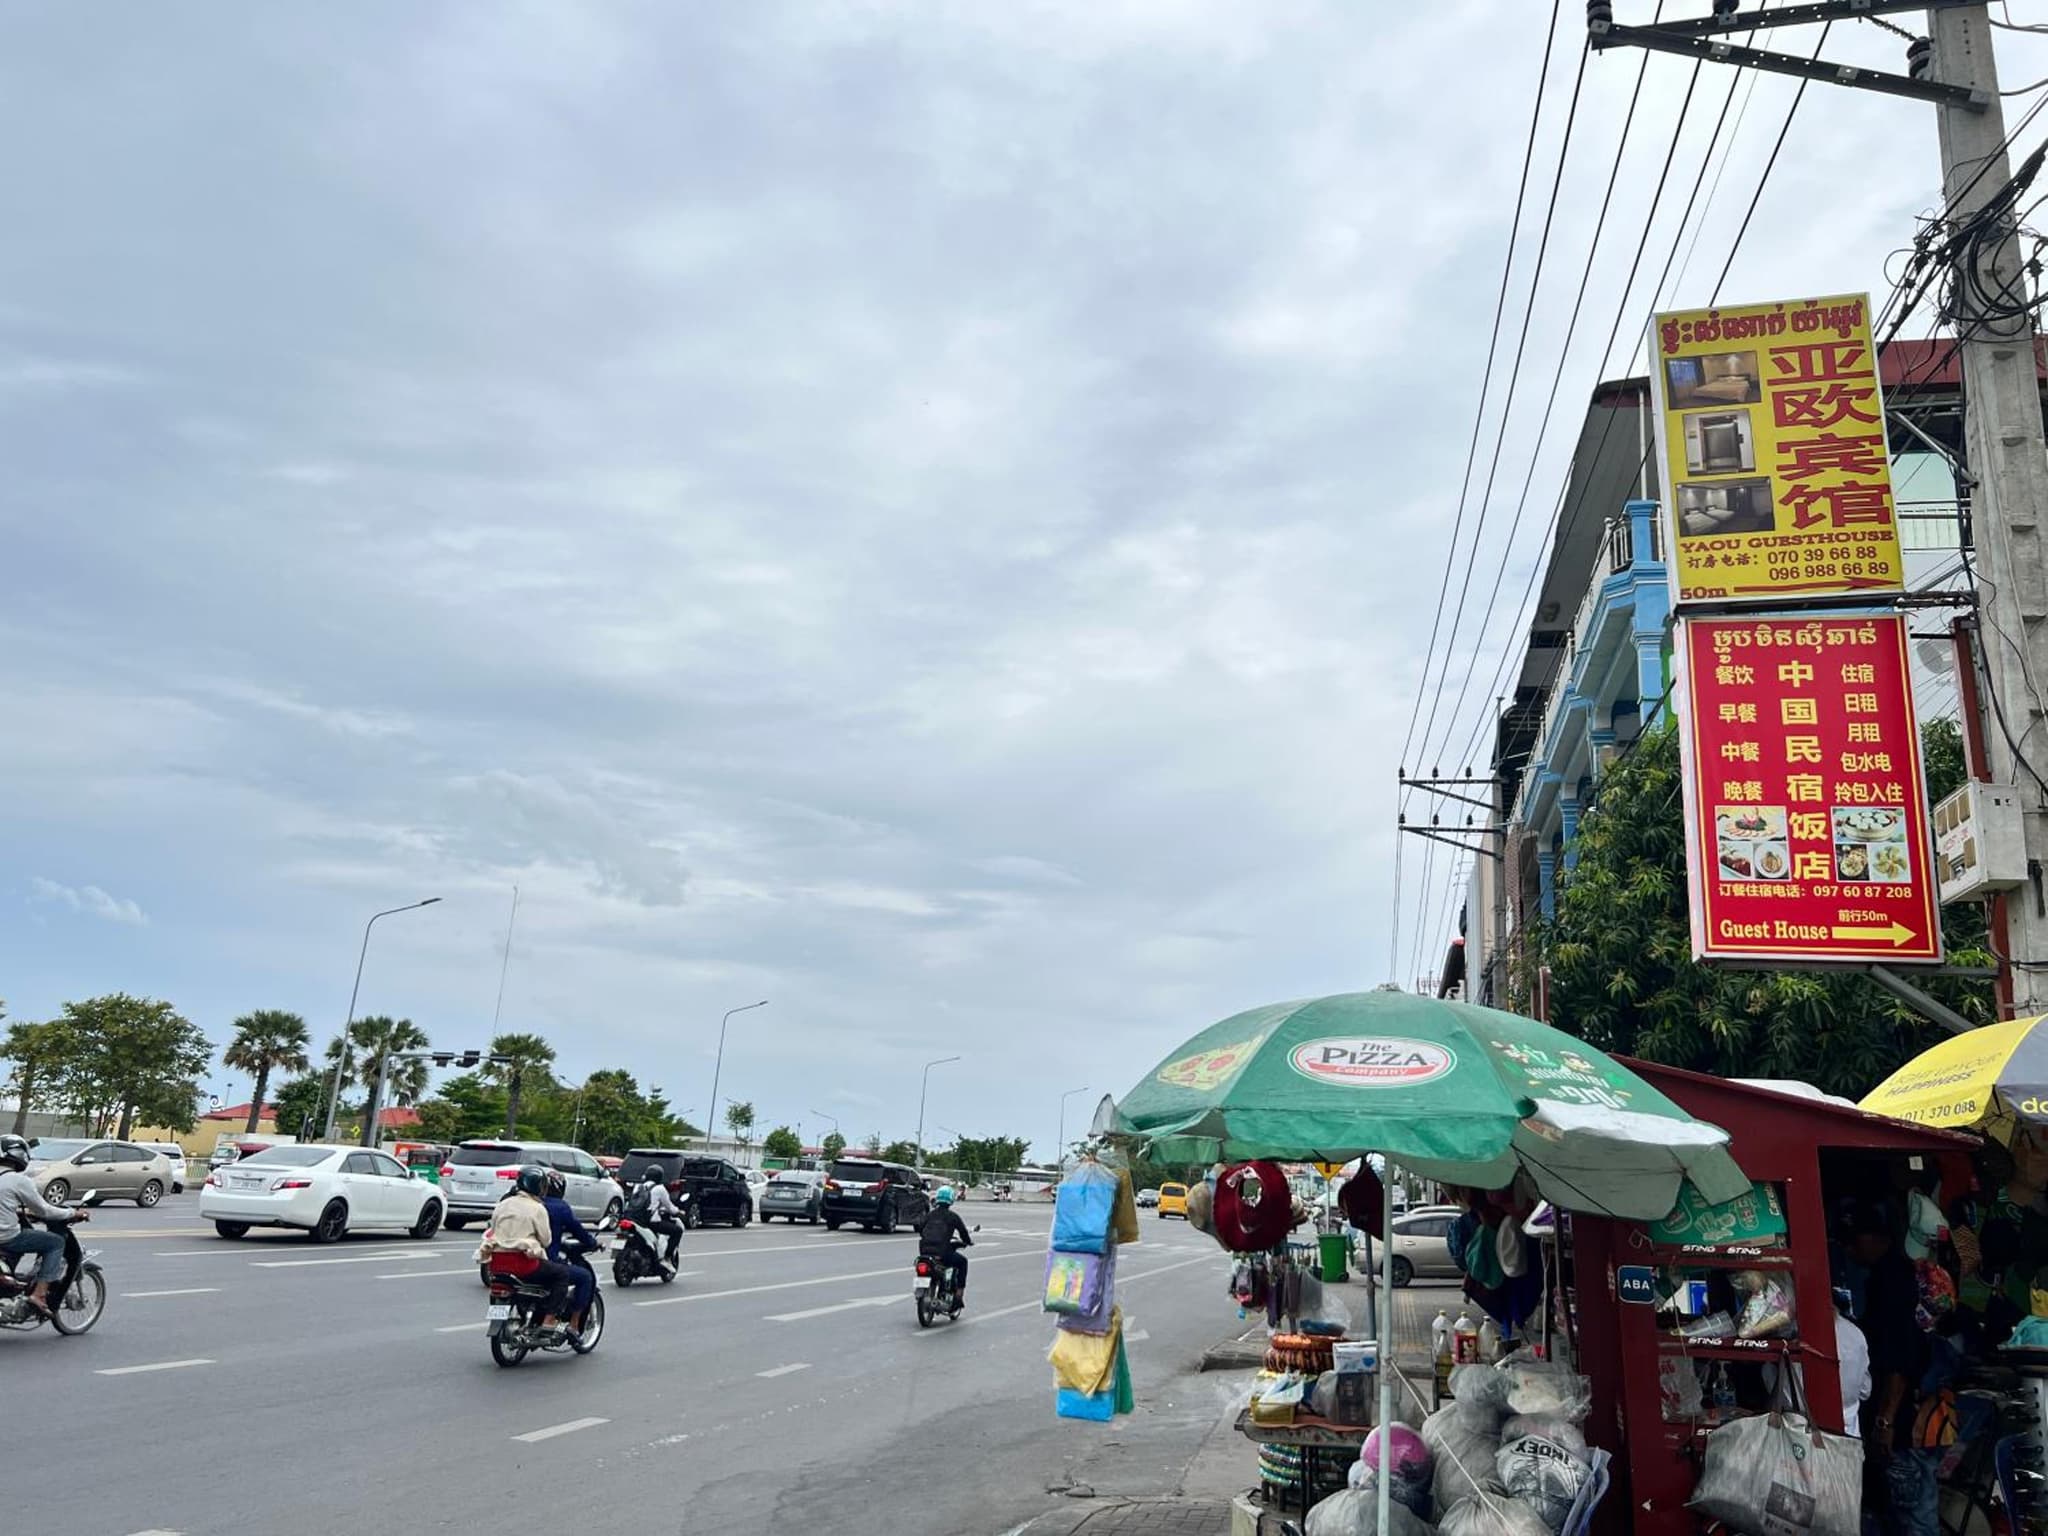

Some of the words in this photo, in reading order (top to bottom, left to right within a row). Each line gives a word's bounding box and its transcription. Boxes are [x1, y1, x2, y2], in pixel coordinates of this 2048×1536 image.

[1767, 340, 1892, 530] 亚欧宾馆
[1680, 538, 1740, 553] YAOU
[1747, 530, 1894, 548] GUESTHOUSE
[1768, 550, 1799, 565] 070
[1804, 549, 1825, 562] 39
[1829, 547, 1851, 560] 66
[1855, 546, 1877, 559] 88
[1769, 566, 1800, 581] 096
[1805, 564, 1837, 578] 988
[1841, 562, 1863, 576] 66
[1868, 561, 1889, 575] 89
[1680, 586, 1728, 600] 50m
[1715, 665, 1755, 685] 餐饮
[1841, 664, 1875, 684] 住宿
[1844, 693, 1878, 713] 日租
[1719, 703, 1757, 724] 早餐
[1848, 723, 1881, 743] 月租
[1721, 741, 1760, 762] 中餐
[1777, 660, 1831, 881] 中国民宿饭店
[1840, 752, 1892, 773] 包水电
[1723, 780, 1763, 801] 晚餐
[1834, 782, 1905, 803] 拎包入住
[1813, 886, 1838, 897] 097
[1843, 886, 1861, 898] 60
[1864, 886, 1881, 898] 87
[1886, 886, 1913, 898] 208
[1838, 909, 1888, 923] 前行50m
[1720, 919, 1769, 939] Guest
[1774, 920, 1829, 940] House
[1361, 1042, 1392, 1052] The
[1929, 1105, 1951, 1119] 370
[1682, 1244, 1716, 1253] STING
[1727, 1246, 1762, 1255] STING
[1623, 1279, 1650, 1290] ABA
[1688, 1336, 1723, 1346] STING
[1733, 1339, 1769, 1348] STING
